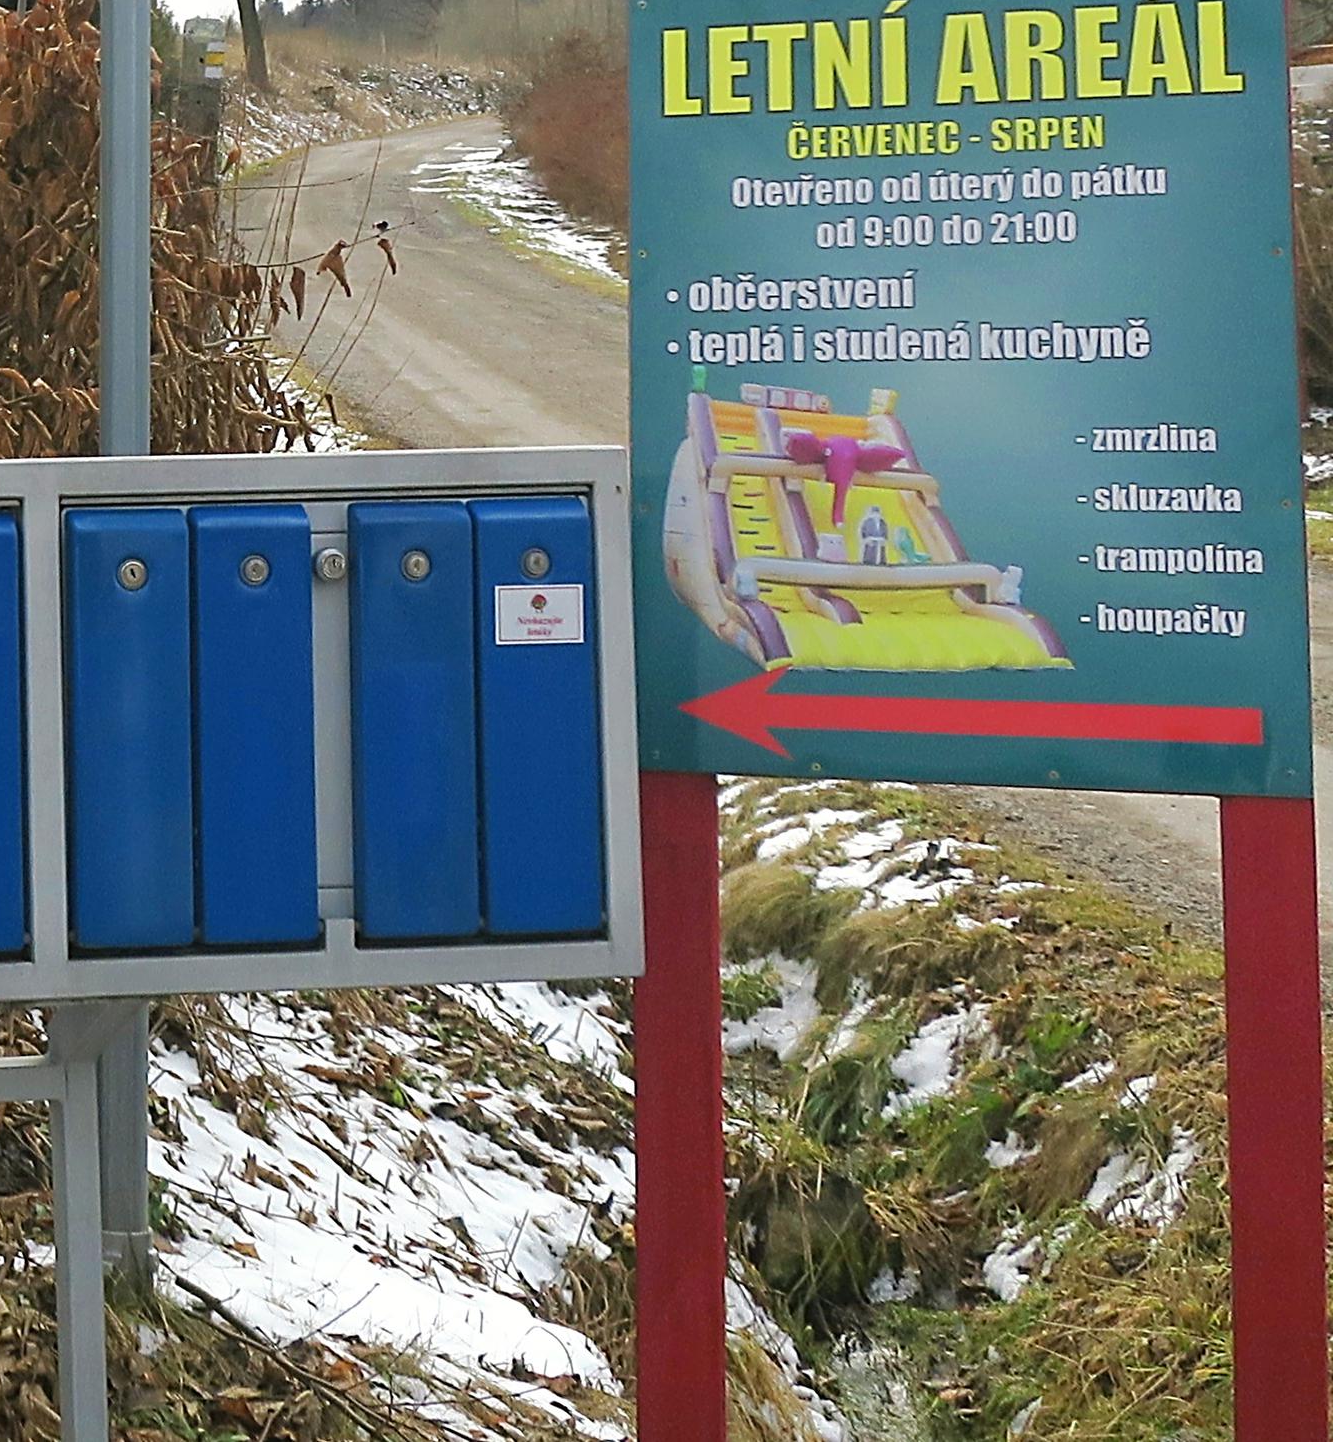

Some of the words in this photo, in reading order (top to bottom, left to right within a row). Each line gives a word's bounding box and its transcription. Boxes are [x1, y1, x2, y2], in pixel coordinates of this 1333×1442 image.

[786, 119, 960, 160] ČERVENEC
[991, 115, 1106, 151] SRPEN
[731, 172, 875, 208] Otevřeno
[882, 170, 923, 204] od
[929, 168, 1016, 204] úterý
[1023, 167, 1064, 200] do
[1071, 163, 1167, 201] pátku
[816, 218, 857, 250] od
[863, 214, 935, 248] 9:00
[941, 214, 983, 246] do
[990, 211, 1078, 244] 21:00
[687, 270, 917, 312] občerstvení
[688, 325, 784, 367] teplá
[792, 326, 805, 361] i
[813, 321, 970, 361] studená
[979, 318, 1152, 361] kuchyně
[1091, 423, 1218, 454] zmrzlina
[1094, 482, 1243, 514] skluzavka
[1096, 541, 1265, 576] trampolína
[1097, 602, 1247, 638] houpačky
